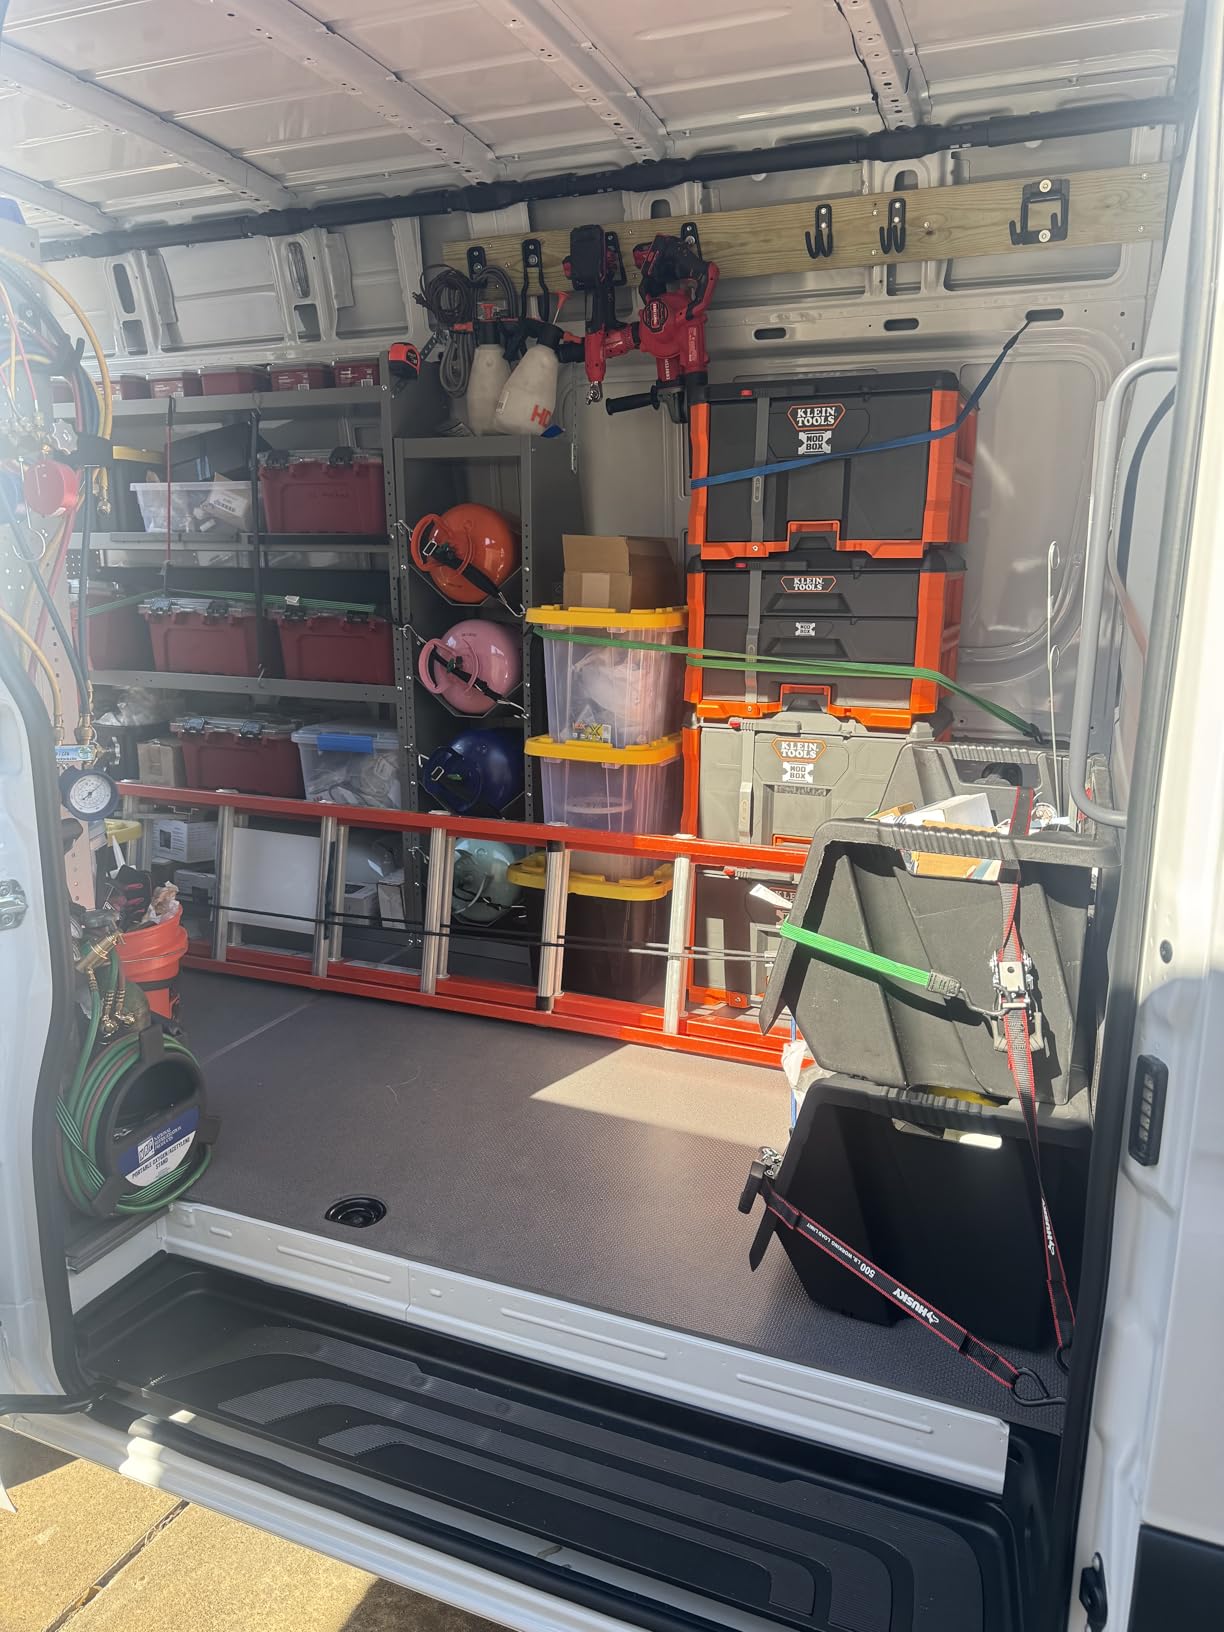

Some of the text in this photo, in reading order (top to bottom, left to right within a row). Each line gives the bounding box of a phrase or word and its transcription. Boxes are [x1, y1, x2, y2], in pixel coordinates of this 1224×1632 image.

[797, 407, 836, 418] KLEIN
[796, 416, 835, 426] TOOLS
[806, 435, 824, 443] MOD
[805, 443, 824, 451] BOX
[793, 577, 823, 585] KLEIN
[793, 583, 823, 591] TOOLS
[781, 741, 818, 751] KLEIN
[781, 750, 817, 759] TOOLS
[790, 765, 806, 773] MOD
[789, 772, 806, 780] BOX
[155, 1157, 169, 1170] STAND
[806, 1222, 819, 1234] LIMIT
[818, 1231, 832, 1243] LOAD
[831, 1240, 853, 1260] WORKING
[860, 1262, 876, 1279] 500
[892, 1287, 929, 1317] HUSKY
